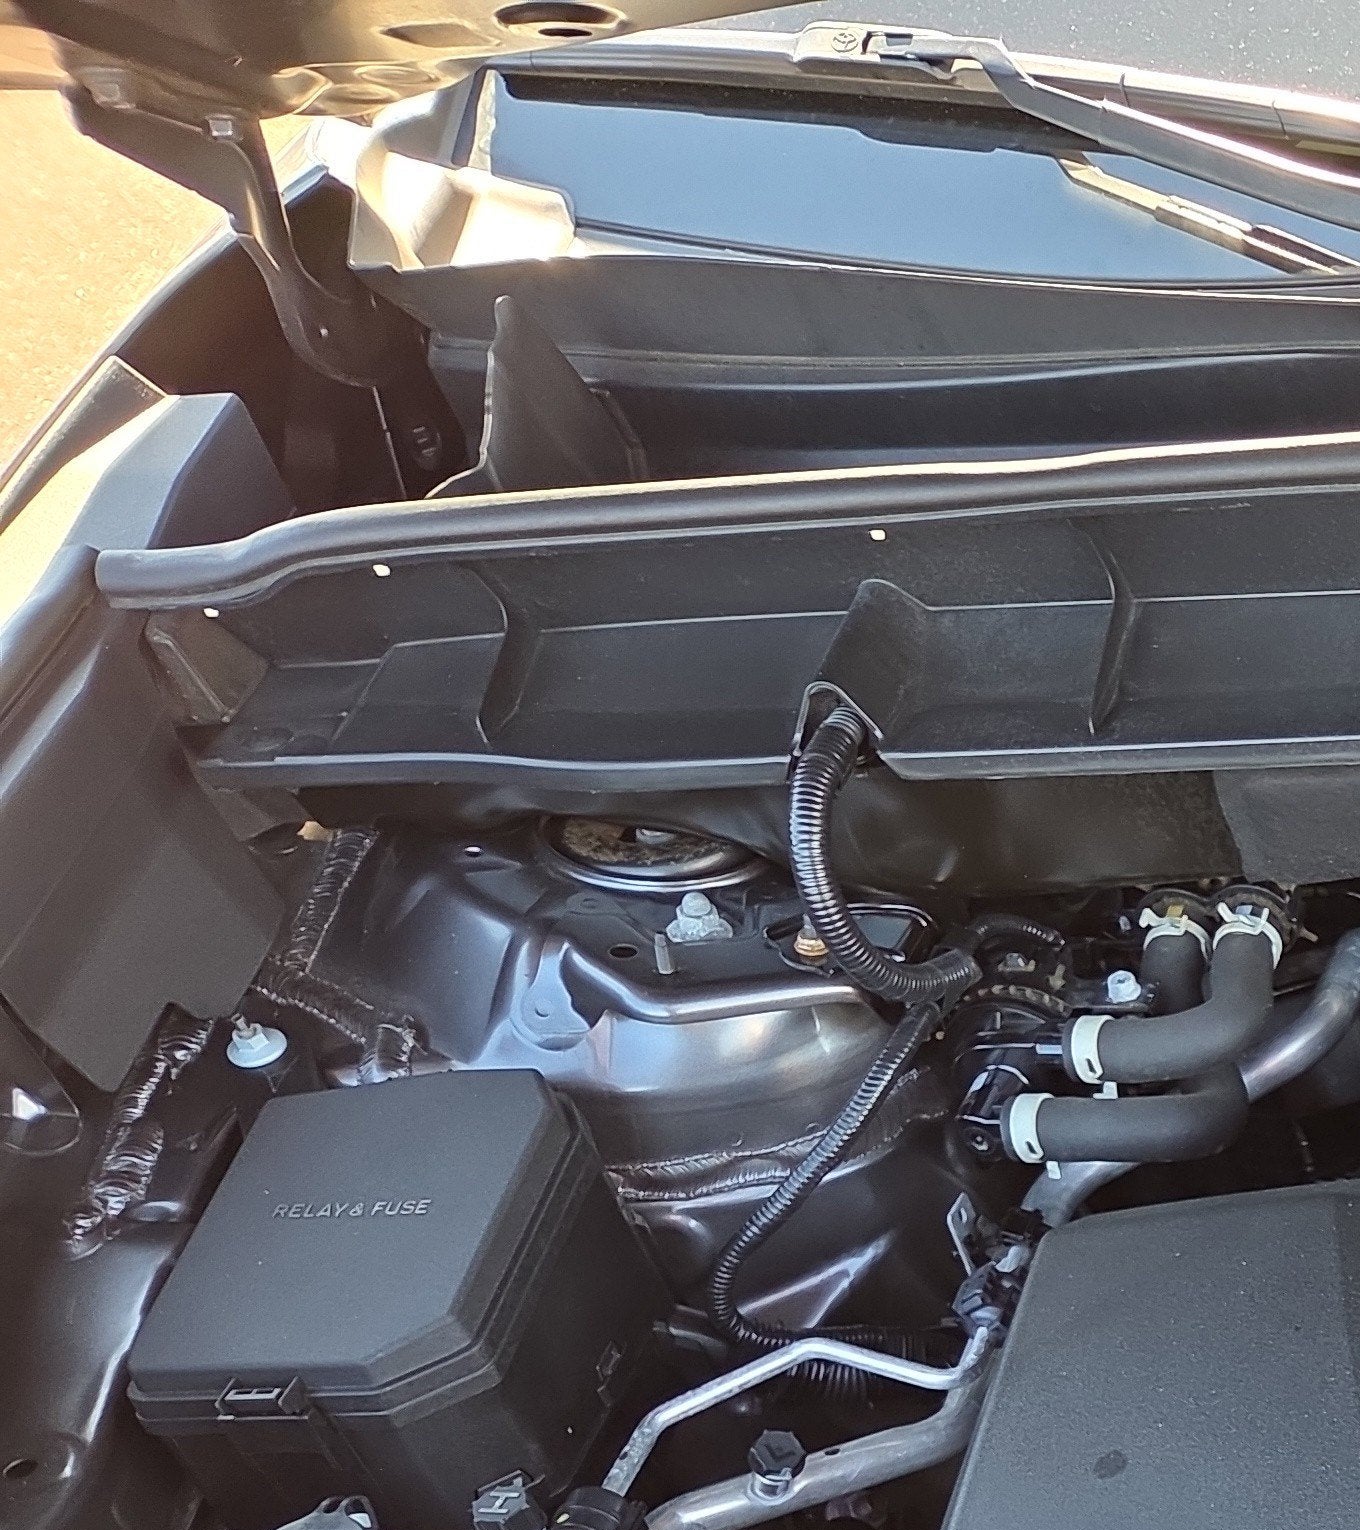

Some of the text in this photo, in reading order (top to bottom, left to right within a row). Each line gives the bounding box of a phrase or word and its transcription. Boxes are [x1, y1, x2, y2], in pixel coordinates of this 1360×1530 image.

[271, 1198, 432, 1219] RELAY & FUSE
[477, 1491, 521, 1514] H
